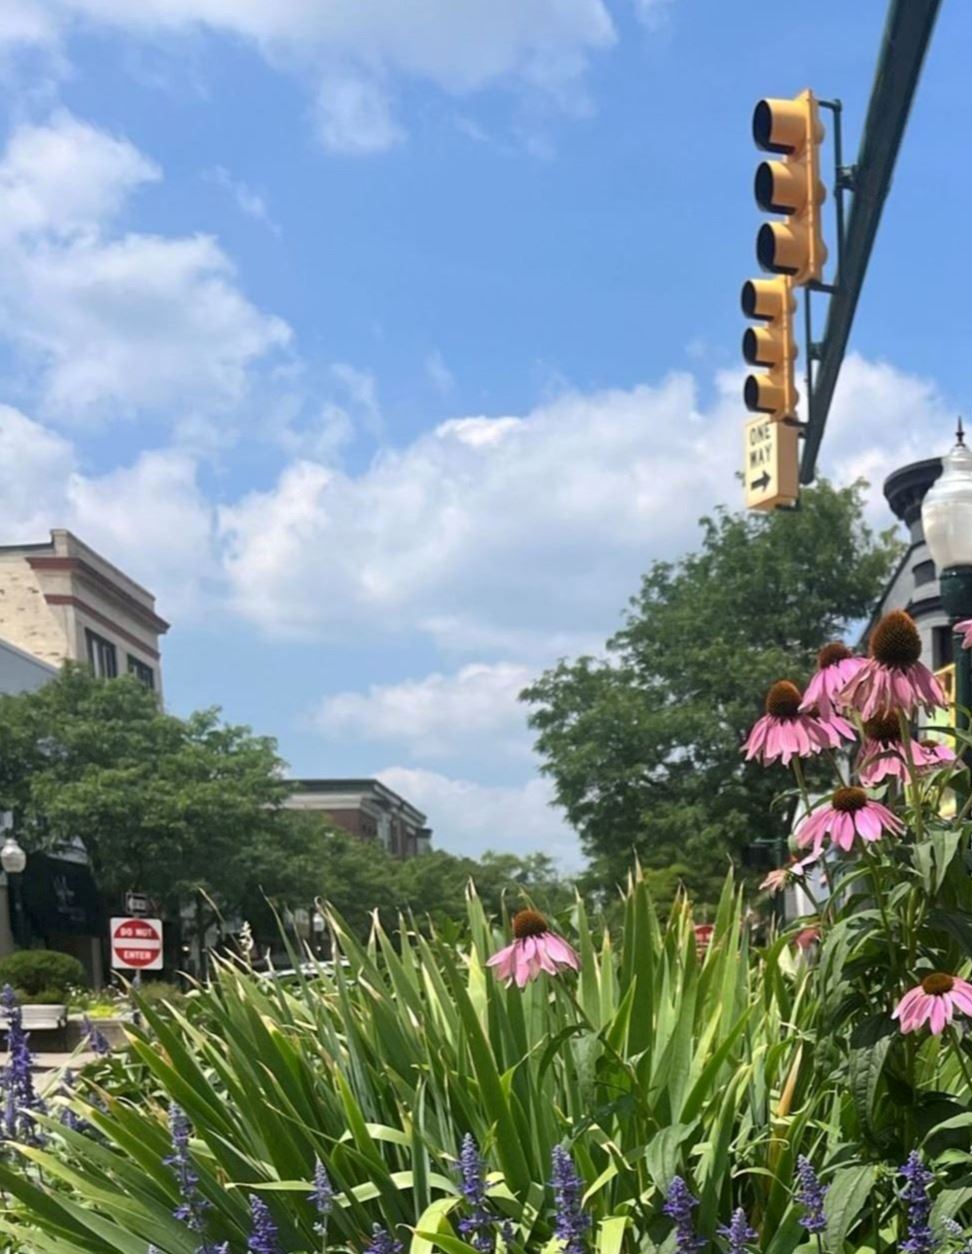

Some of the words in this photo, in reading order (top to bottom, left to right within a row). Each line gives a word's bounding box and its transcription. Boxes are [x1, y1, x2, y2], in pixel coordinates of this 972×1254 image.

[750, 423, 770, 446] ONE
[750, 443, 772, 468] WAY
[120, 927, 133, 936] DO
[135, 928, 152, 937] NOT
[123, 950, 151, 959] ENTER
